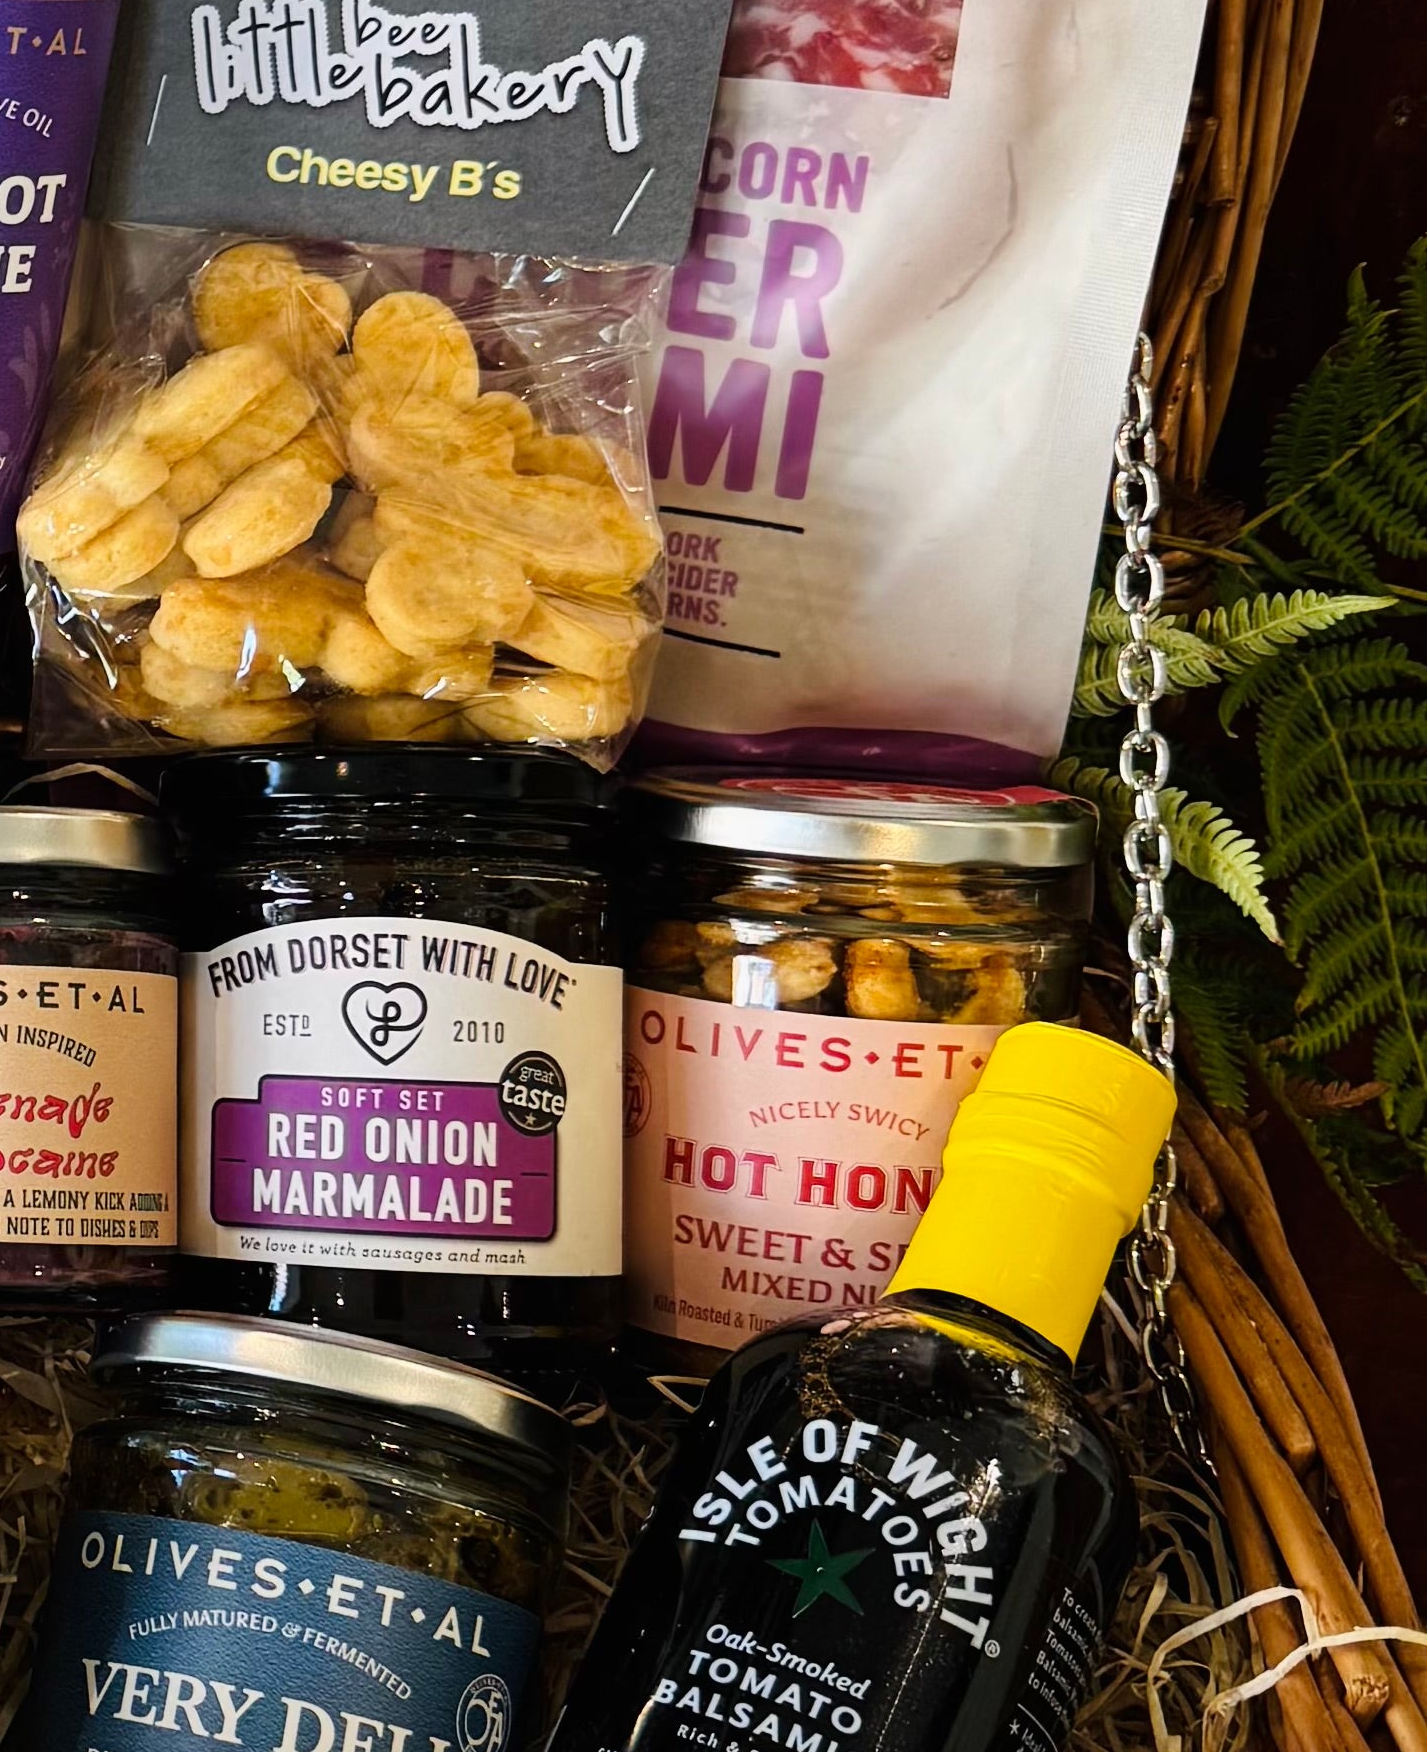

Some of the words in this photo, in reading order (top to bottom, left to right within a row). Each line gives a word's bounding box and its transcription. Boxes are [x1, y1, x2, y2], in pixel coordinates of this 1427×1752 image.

[372, 21, 635, 145] bakery
[22, 109, 54, 137] OIL
[267, 145, 440, 201] Cheesy
[208, 943, 279, 998] FROM
[287, 933, 410, 973] DORSET
[421, 936, 496, 983] WITH
[17, 1025, 97, 1068] INSPIRED
[267, 1113, 345, 1161] RED
[365, 1117, 499, 1167] ONION
[749, 1101, 841, 1128] NICELY
[847, 1104, 931, 1141] SWICY
[662, 1133, 782, 1200] HOT
[253, 1169, 514, 1225] MARMALADE
[705, 1623, 873, 1702] Oak-Smoked
[82, 1658, 265, 1746] VERY
[687, 1649, 863, 1737] TOMATO
